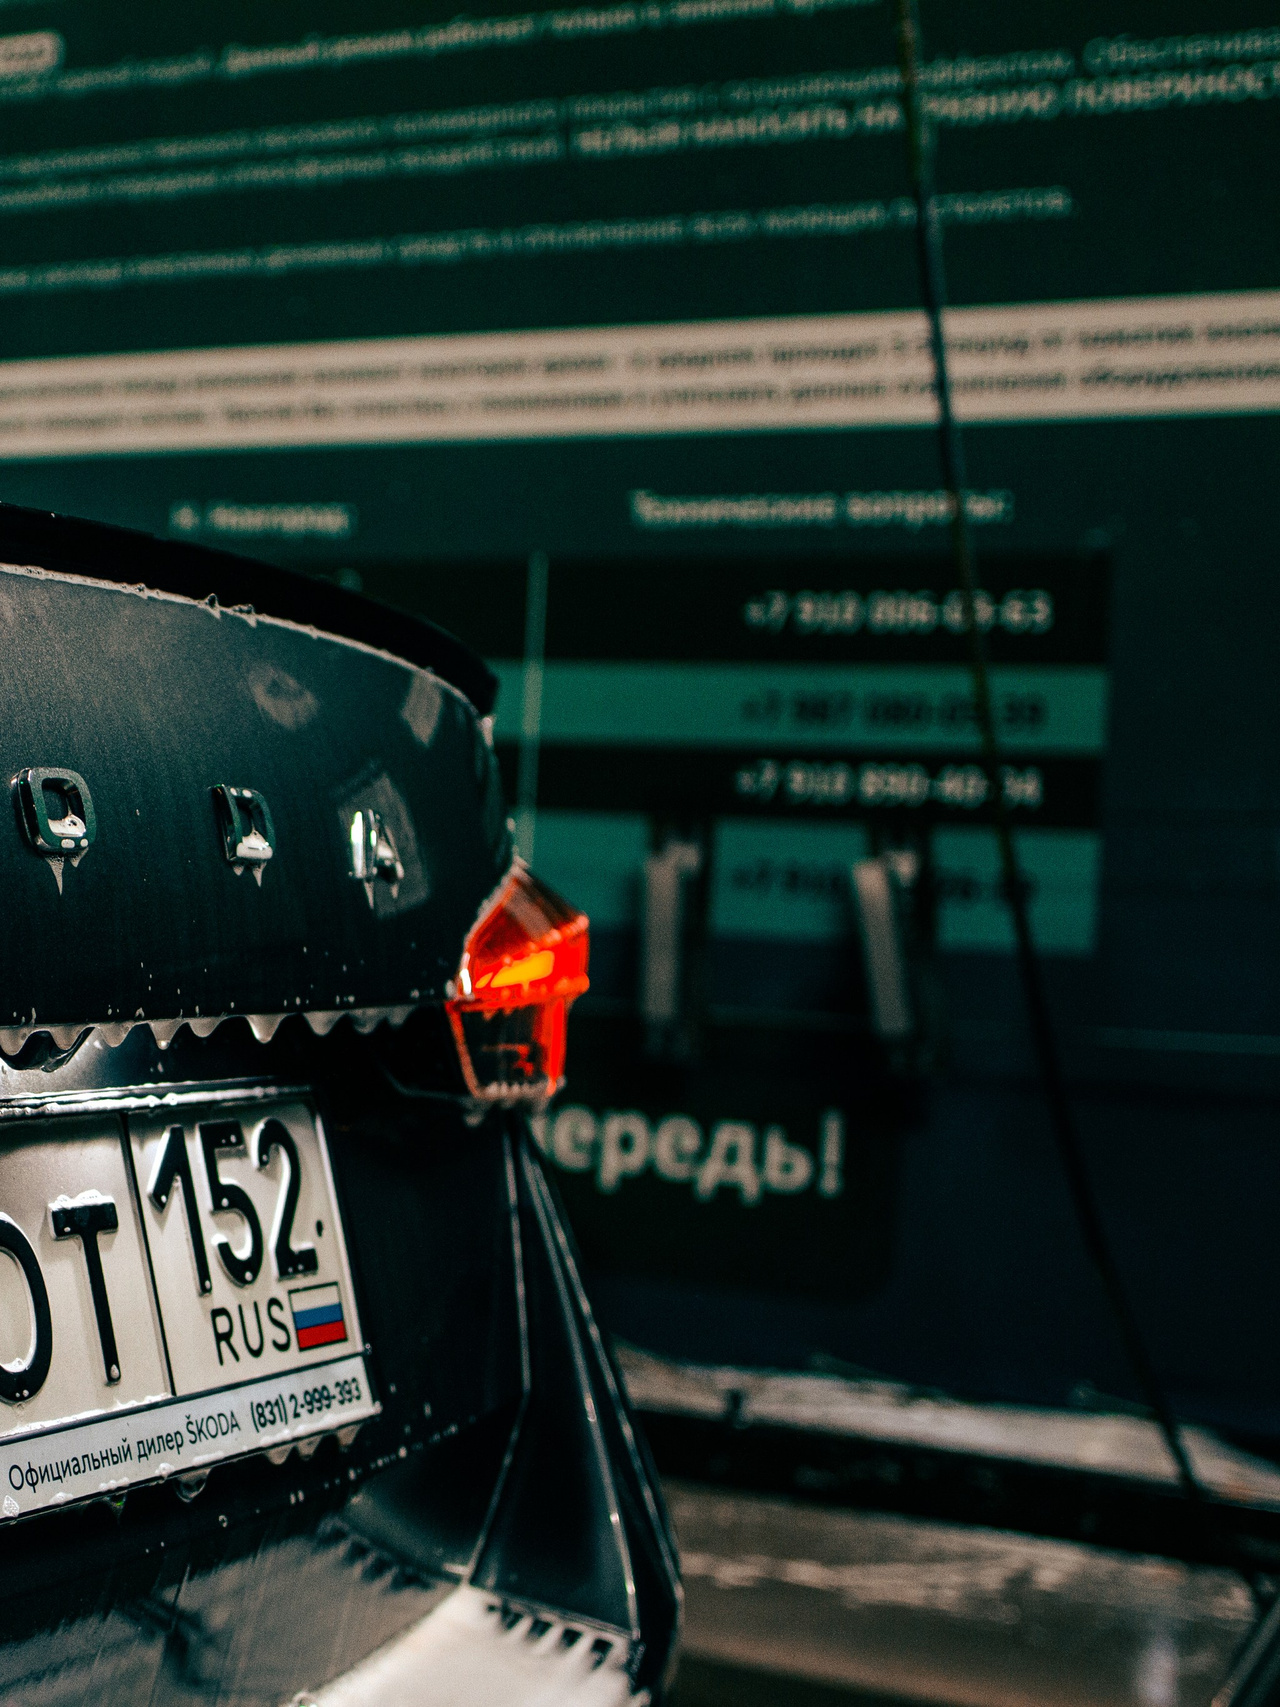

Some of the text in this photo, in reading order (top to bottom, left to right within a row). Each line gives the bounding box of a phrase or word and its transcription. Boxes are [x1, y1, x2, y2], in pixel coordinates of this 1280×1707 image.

[148, 1117, 319, 1296] 152
[528, 1104, 842, 1205] ередь!
[211, 1297, 291, 1365] RUS
[9, 1437, 134, 1494] Официальный
[136, 1431, 184, 1463] дилер
[185, 1410, 242, 1445] ŠKODA
[250, 1397, 289, 1433] (831)
[290, 1376, 362, 1420] 2-999-393
